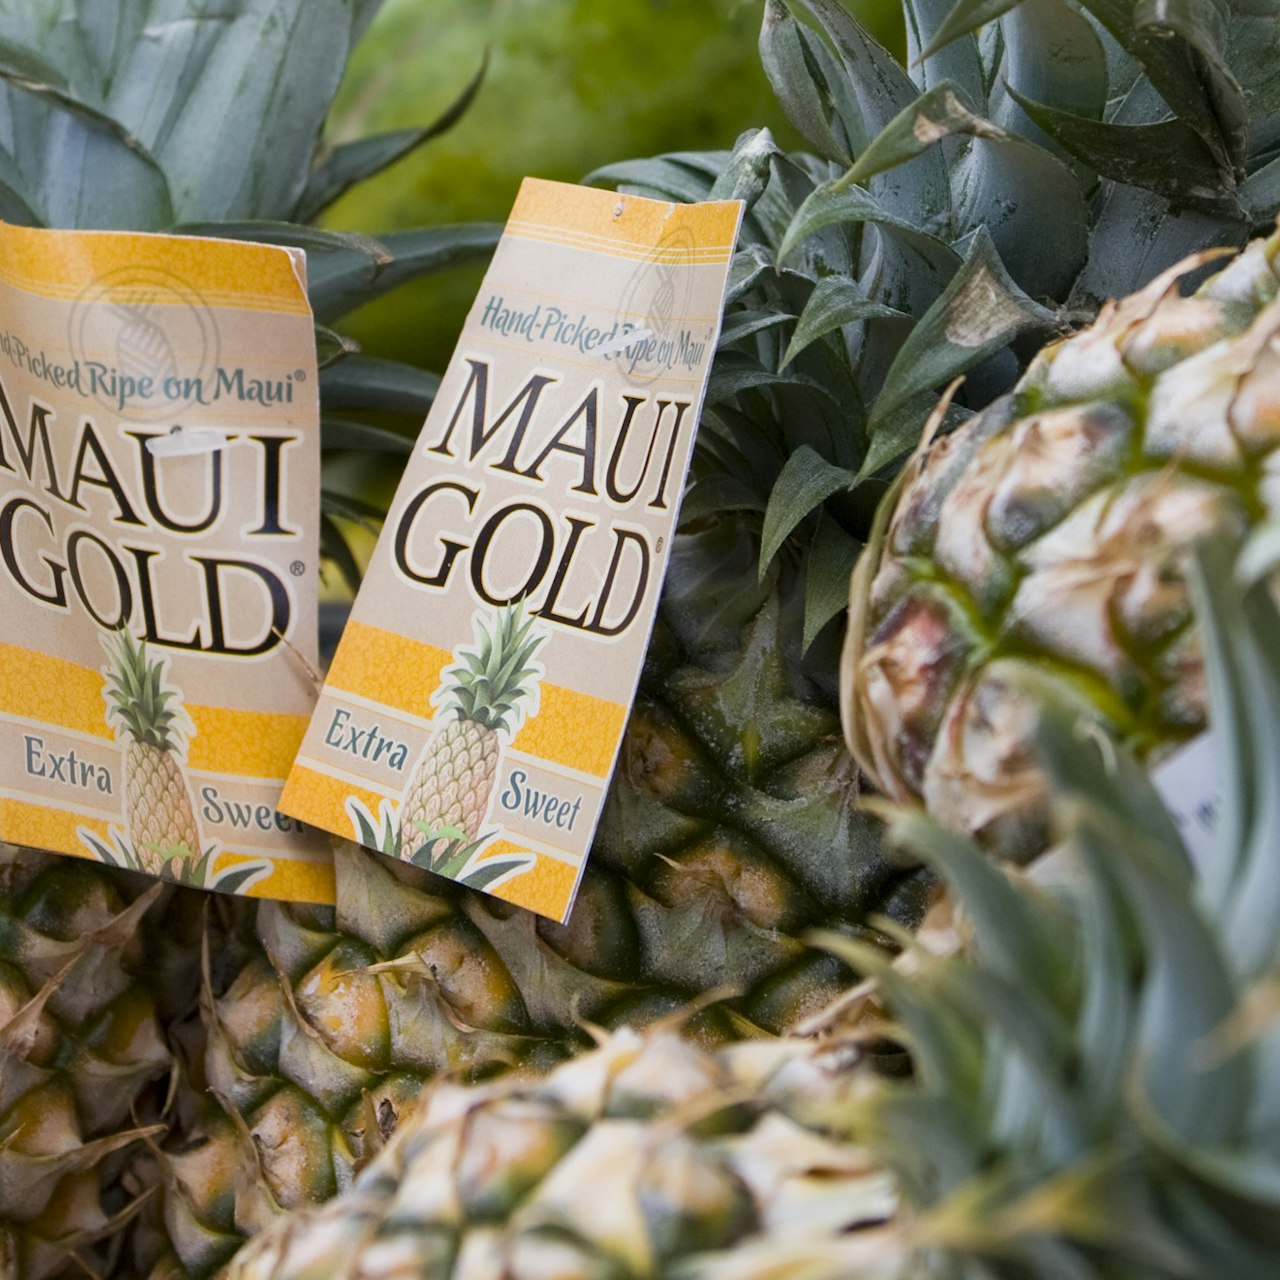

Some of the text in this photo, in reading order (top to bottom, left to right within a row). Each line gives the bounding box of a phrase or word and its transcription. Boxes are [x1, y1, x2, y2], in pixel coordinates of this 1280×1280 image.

[656, 340, 675, 370] on
[81, 361, 153, 410] Ripe
[163, 374, 210, 405] on
[427, 358, 690, 510] MAUI
[24, 736, 113, 795] Extra
[325, 708, 581, 831] Extra Sweet
